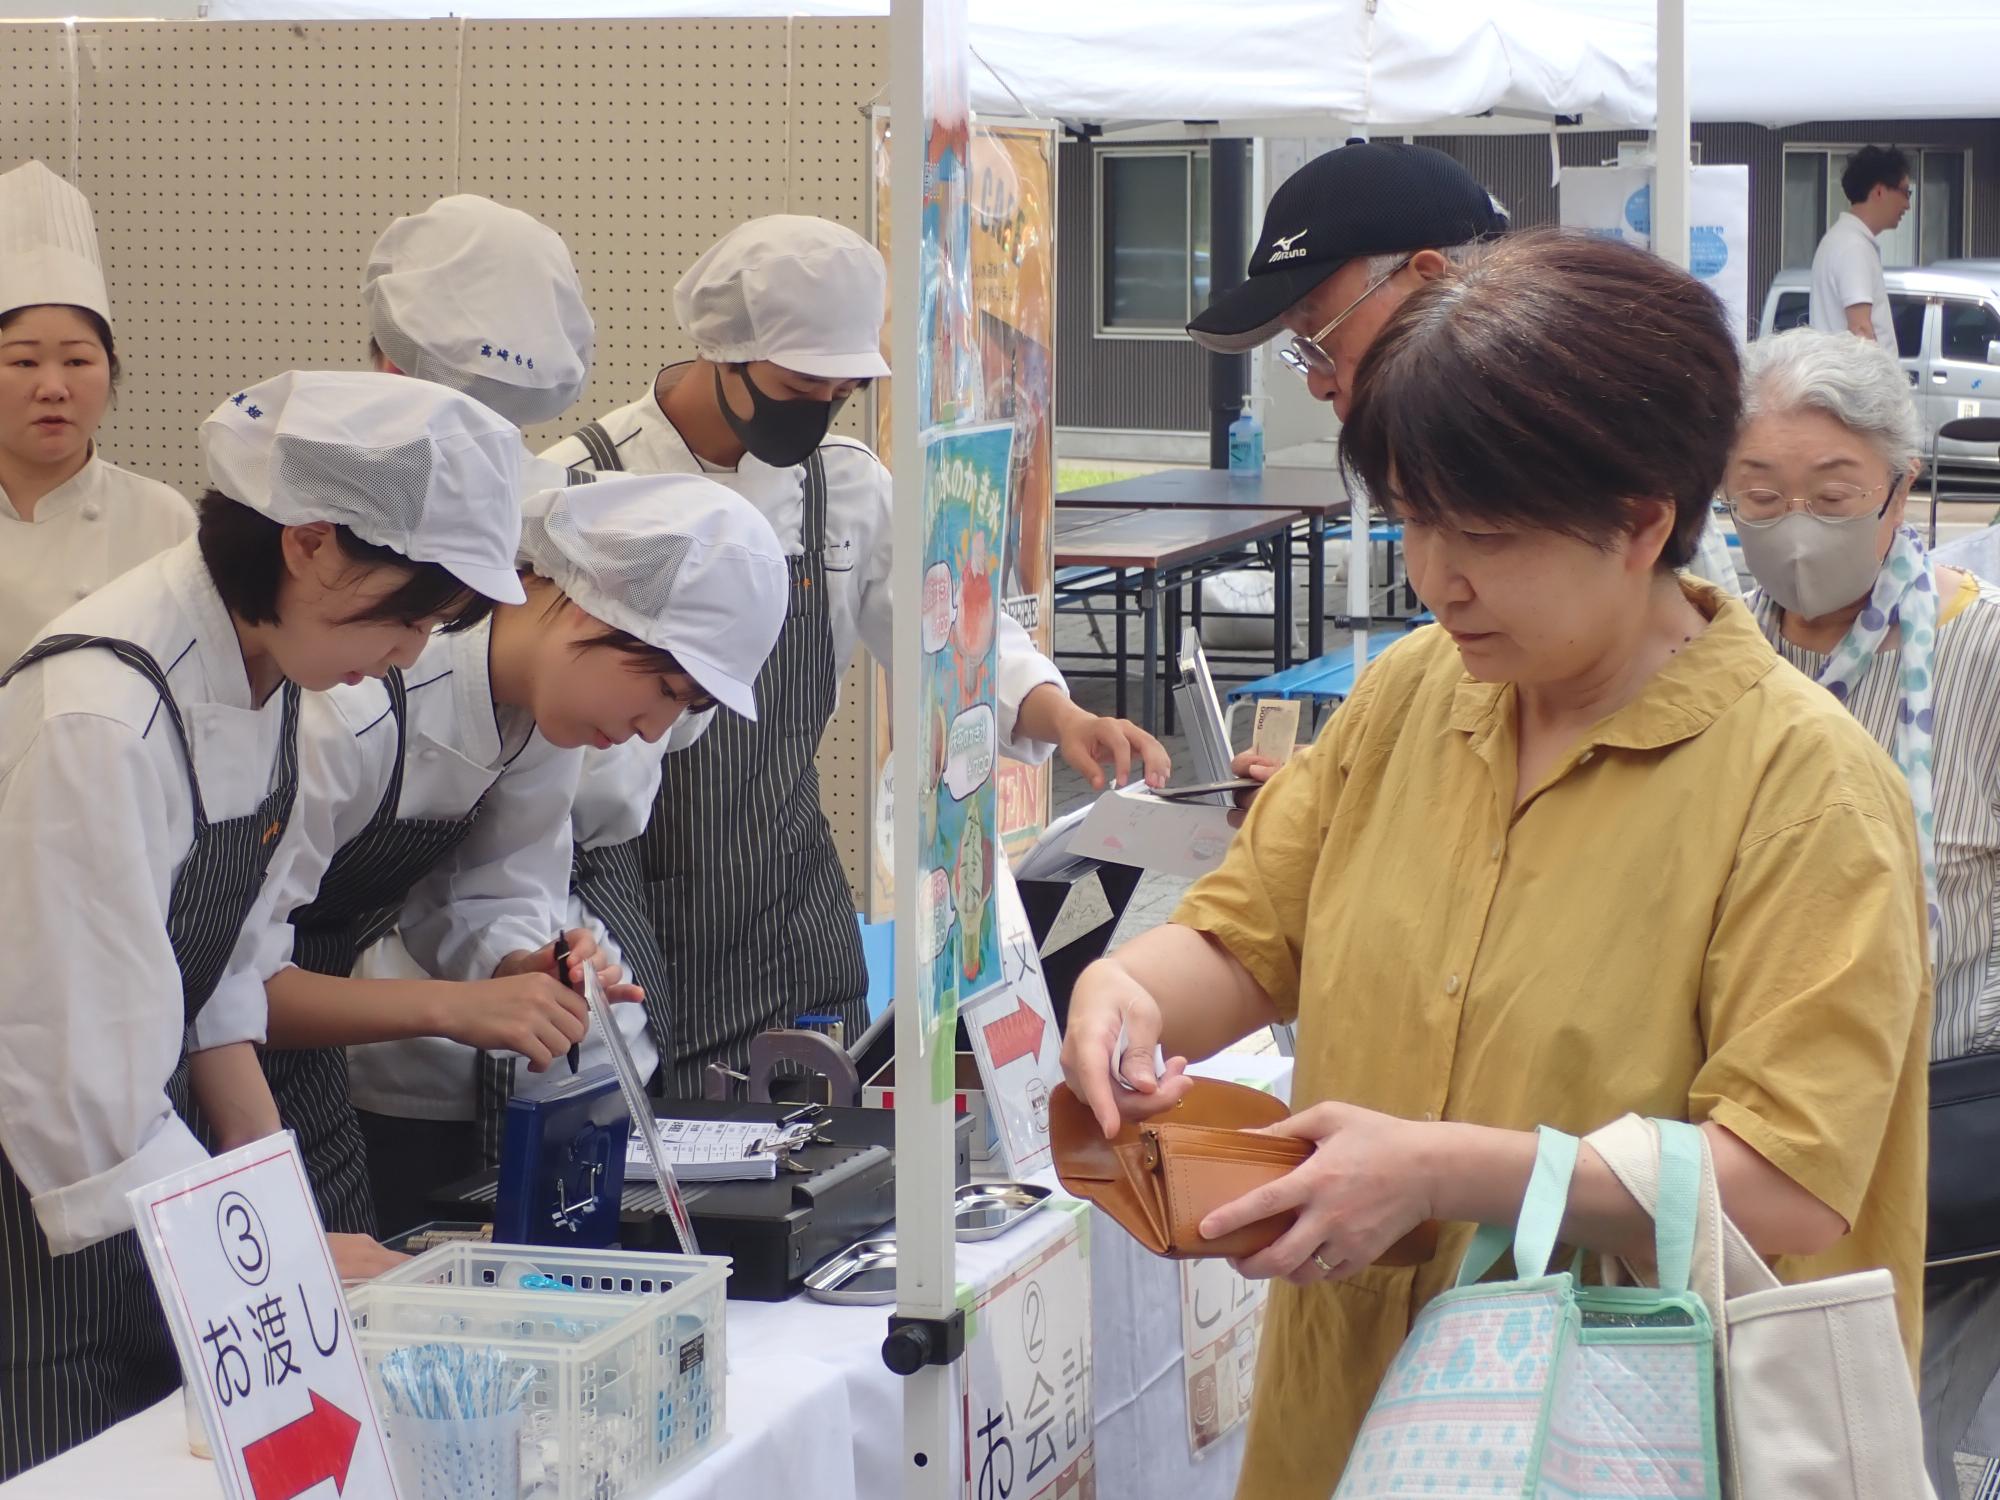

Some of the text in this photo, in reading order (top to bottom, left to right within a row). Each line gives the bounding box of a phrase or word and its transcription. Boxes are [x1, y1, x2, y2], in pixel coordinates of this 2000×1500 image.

[1268, 248, 1307, 263] MIZUNO
[203, 1283, 339, 1407] お渡し
[977, 1335, 1090, 1500] お会計
